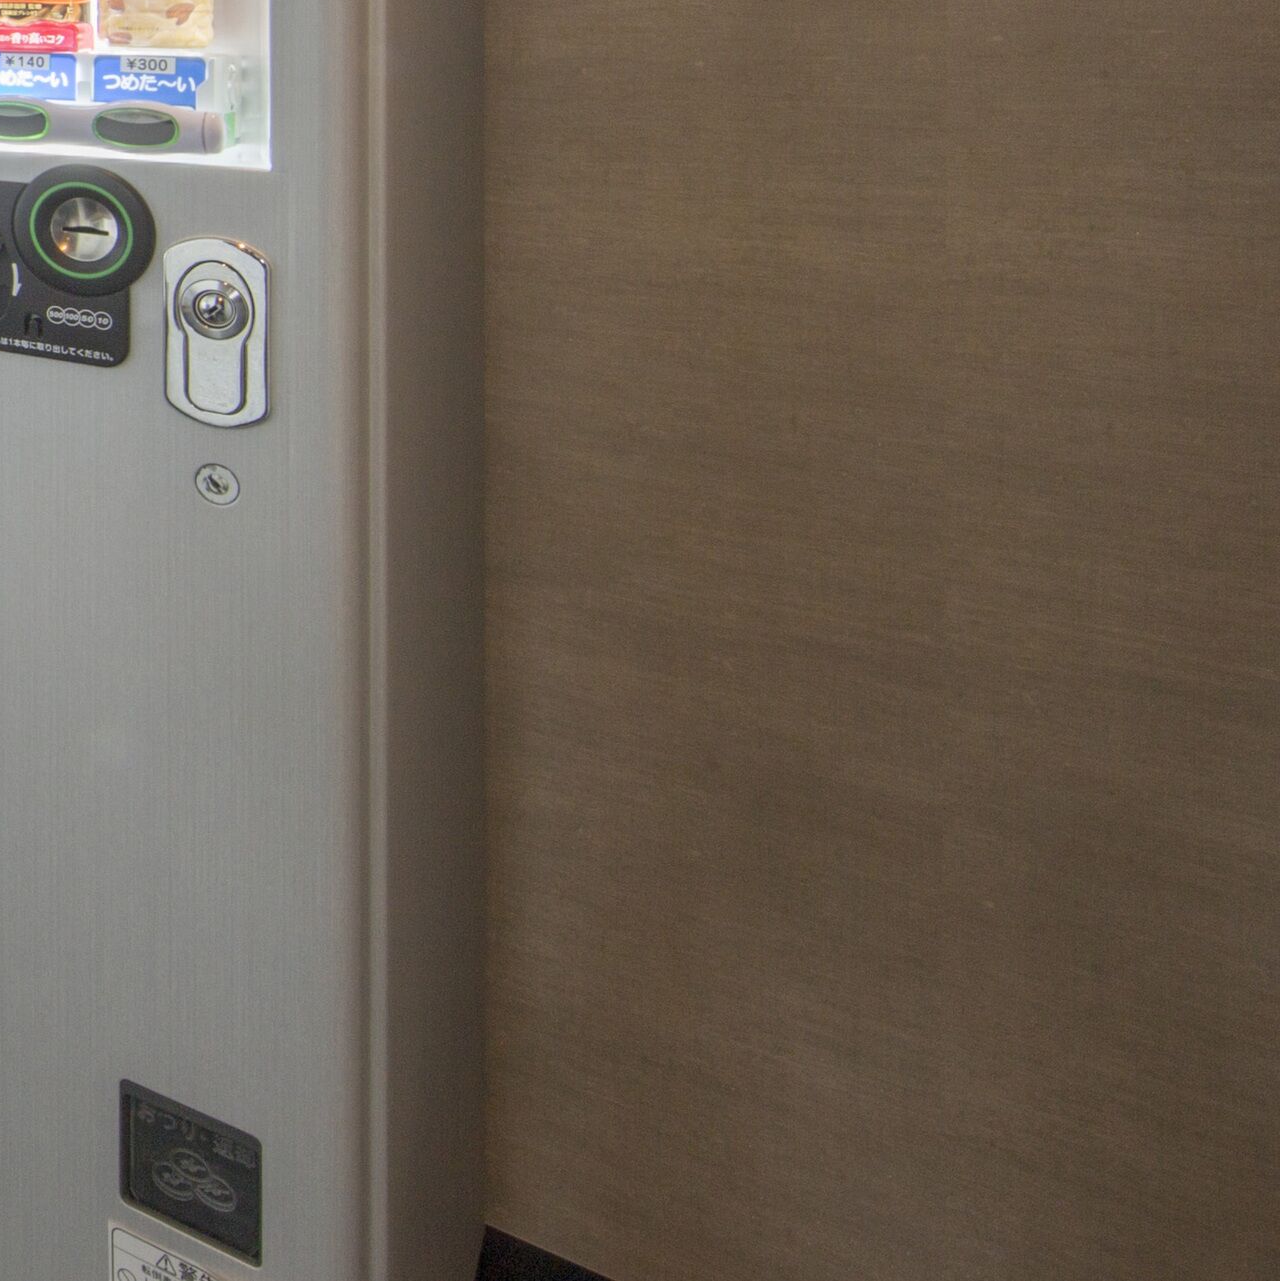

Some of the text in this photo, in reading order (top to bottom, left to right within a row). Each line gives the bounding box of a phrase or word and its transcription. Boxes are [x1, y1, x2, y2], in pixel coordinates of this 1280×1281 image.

[5, 56, 45, 68] ¥140
[126, 58, 168, 71] ¥300
[65, 314, 79, 322] 100
[81, 315, 94, 323] 50
[97, 317, 109, 325] 10
